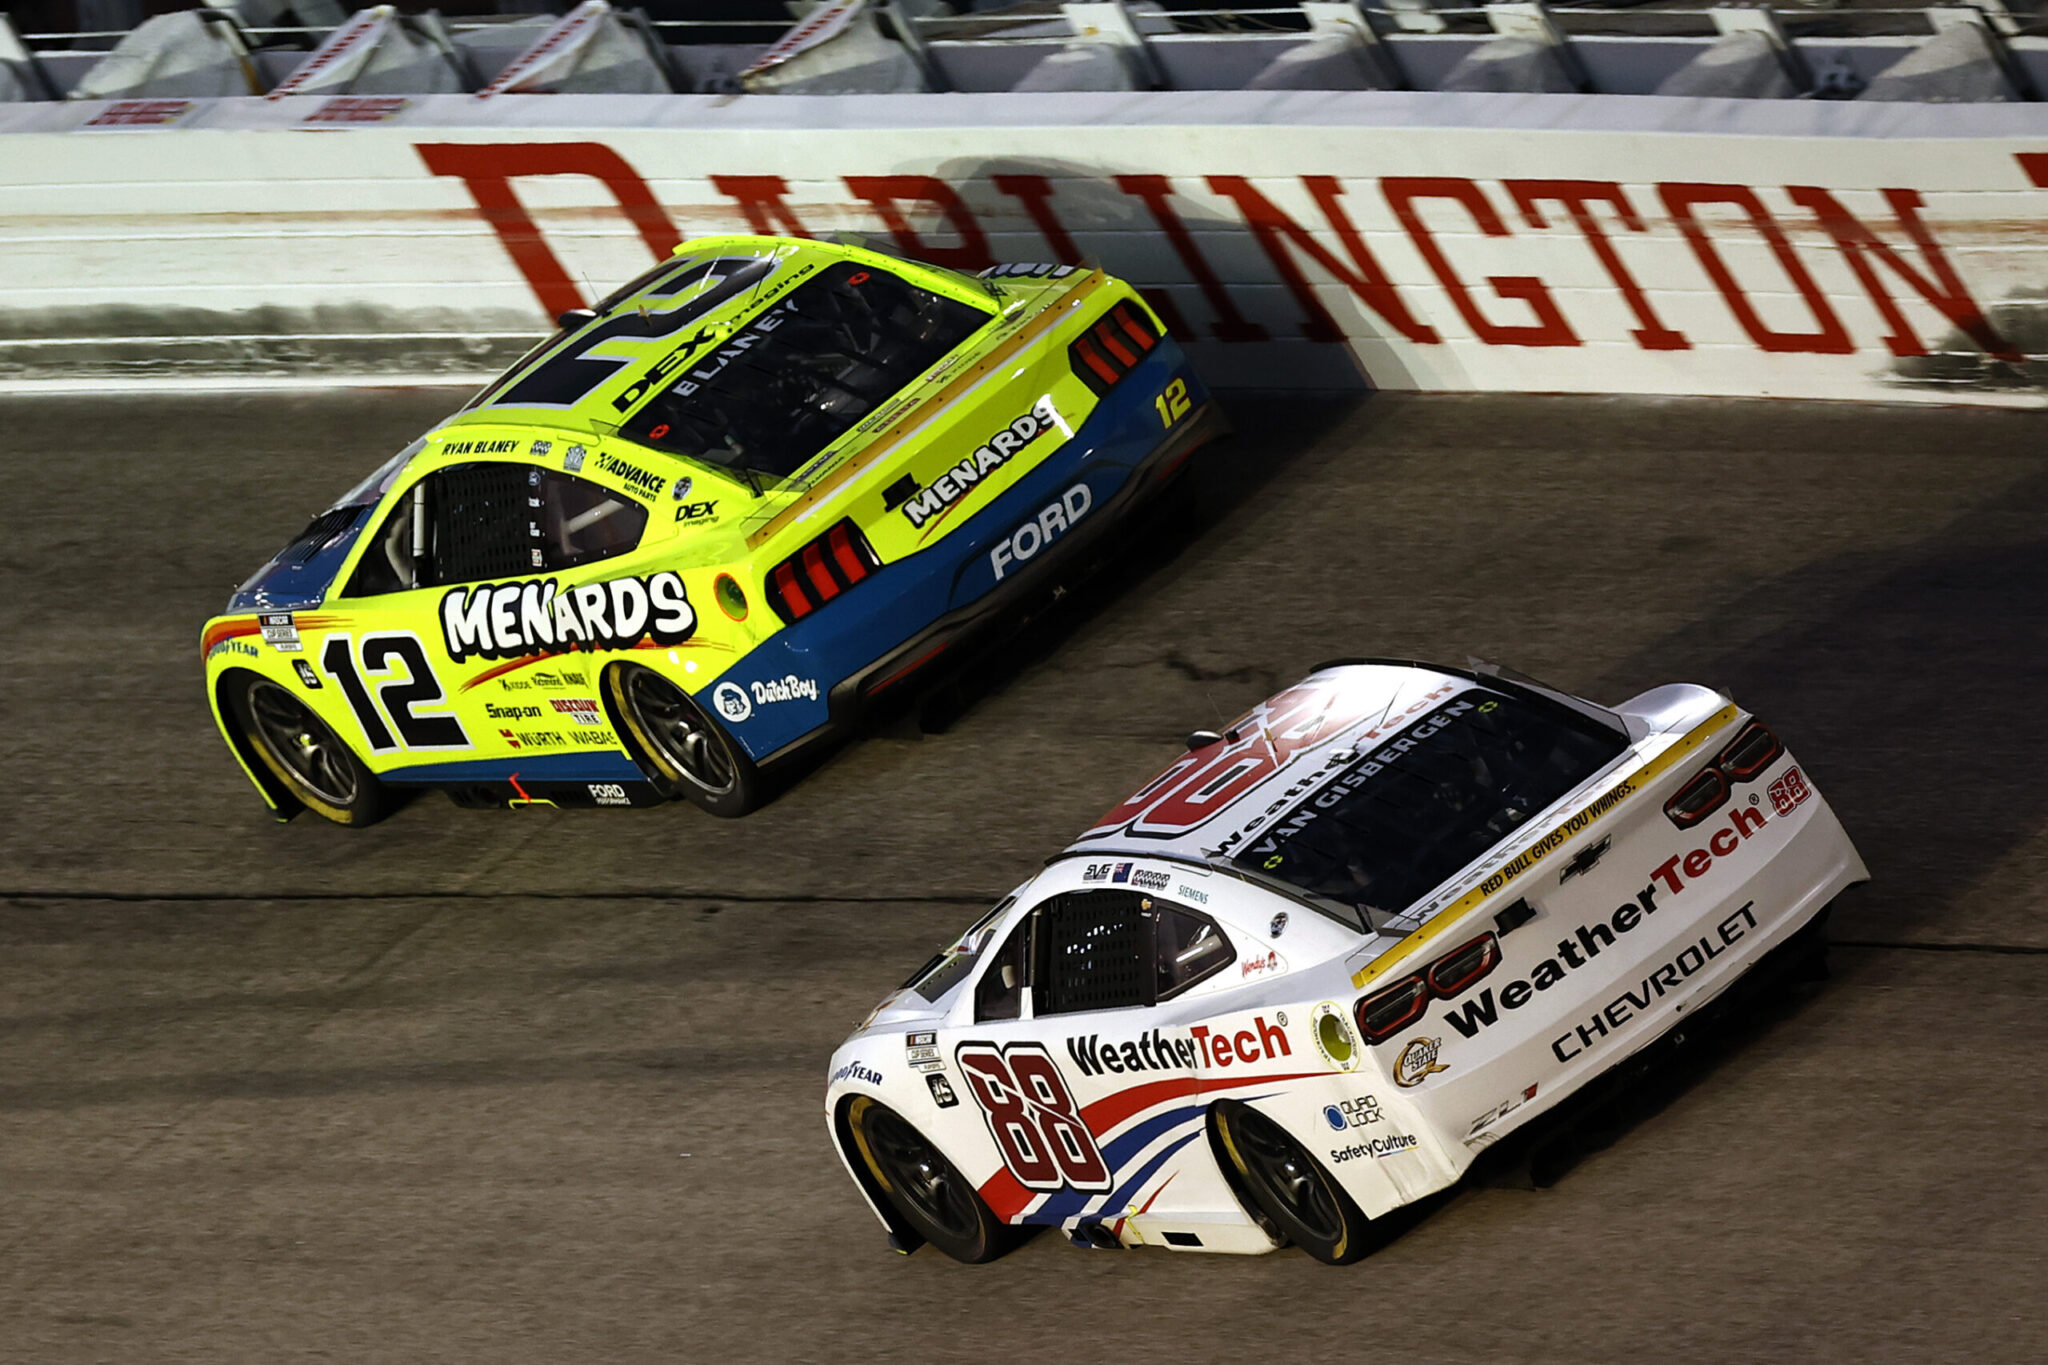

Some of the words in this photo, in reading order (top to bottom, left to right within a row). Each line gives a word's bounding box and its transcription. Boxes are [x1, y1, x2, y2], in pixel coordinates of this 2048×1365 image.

[611, 325, 707, 414] DEX
[672, 298, 799, 397] BLANEY
[1154, 378, 1192, 431] 12
[442, 443, 472, 456] RYAN
[474, 440, 520, 454] BLANEY
[606, 459, 666, 494] ADVANCE
[904, 400, 1058, 529] MENARDS
[675, 500, 719, 522] DEX
[990, 482, 1092, 582] FORD
[442, 571, 697, 660] MENARDS
[319, 629, 475, 756] 12
[587, 784, 626, 798] FORD
[1252, 810, 1318, 853] VAN
[1314, 700, 1475, 808] GISBERGEN
[1767, 765, 1812, 818] 88
[1480, 873, 1504, 896] RED
[1504, 858, 1532, 880] BULL
[1532, 833, 1564, 860] GIVES
[1564, 815, 1589, 837] YOU
[1178, 884, 1209, 905] SIEMENS
[1552, 900, 1760, 1061] CHEVROLET
[954, 1040, 1114, 1195] 88
[1340, 1095, 1379, 1114] QUAD
[1347, 1108, 1384, 1128] LOCK
[1330, 1133, 1417, 1163] SafetyCulture
